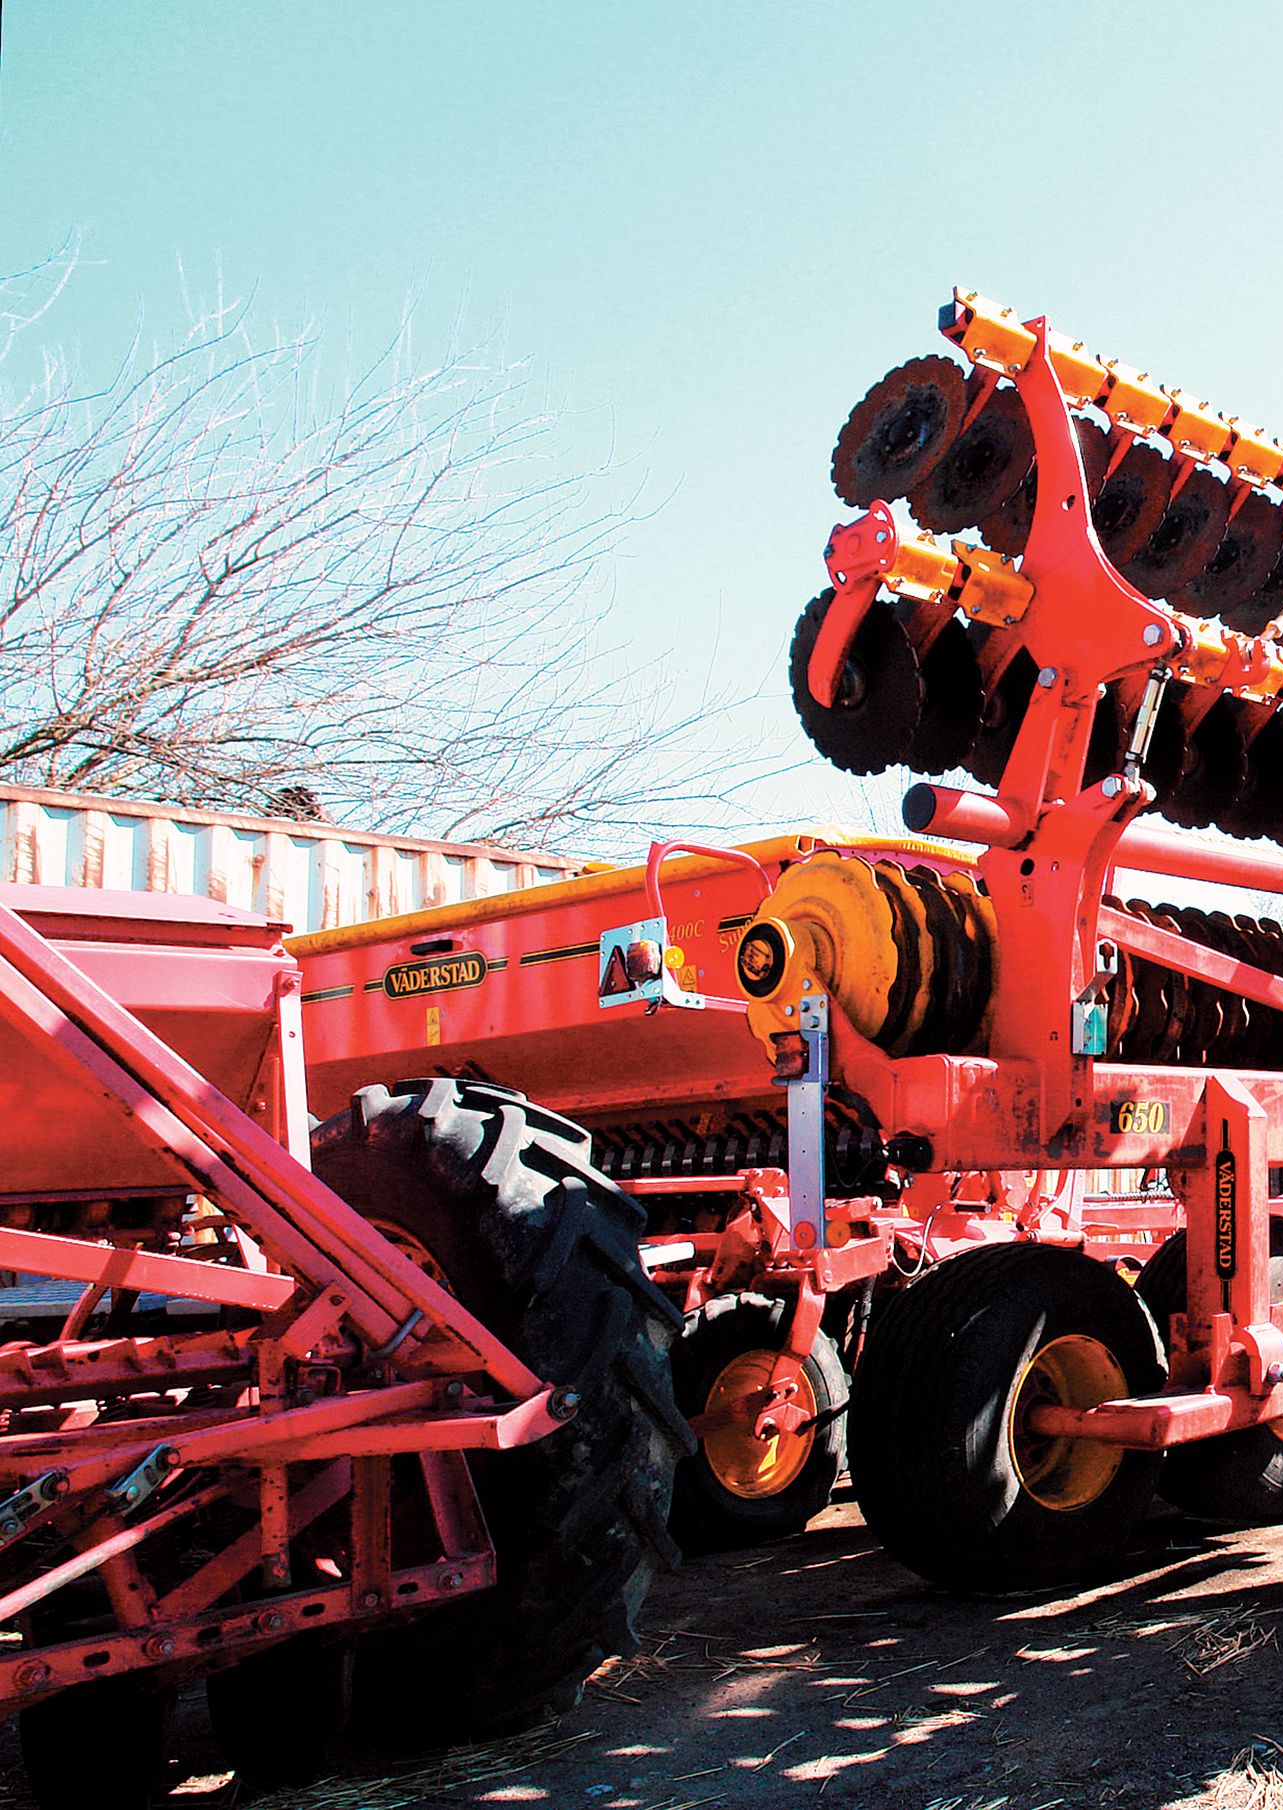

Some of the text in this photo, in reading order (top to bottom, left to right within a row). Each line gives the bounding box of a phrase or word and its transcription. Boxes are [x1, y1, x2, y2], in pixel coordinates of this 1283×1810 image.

[390, 960, 480, 994] VÄDERSTAD
[1118, 1101, 1165, 1134] 650
[1219, 1161, 1235, 1268] VÄDERSTAD
